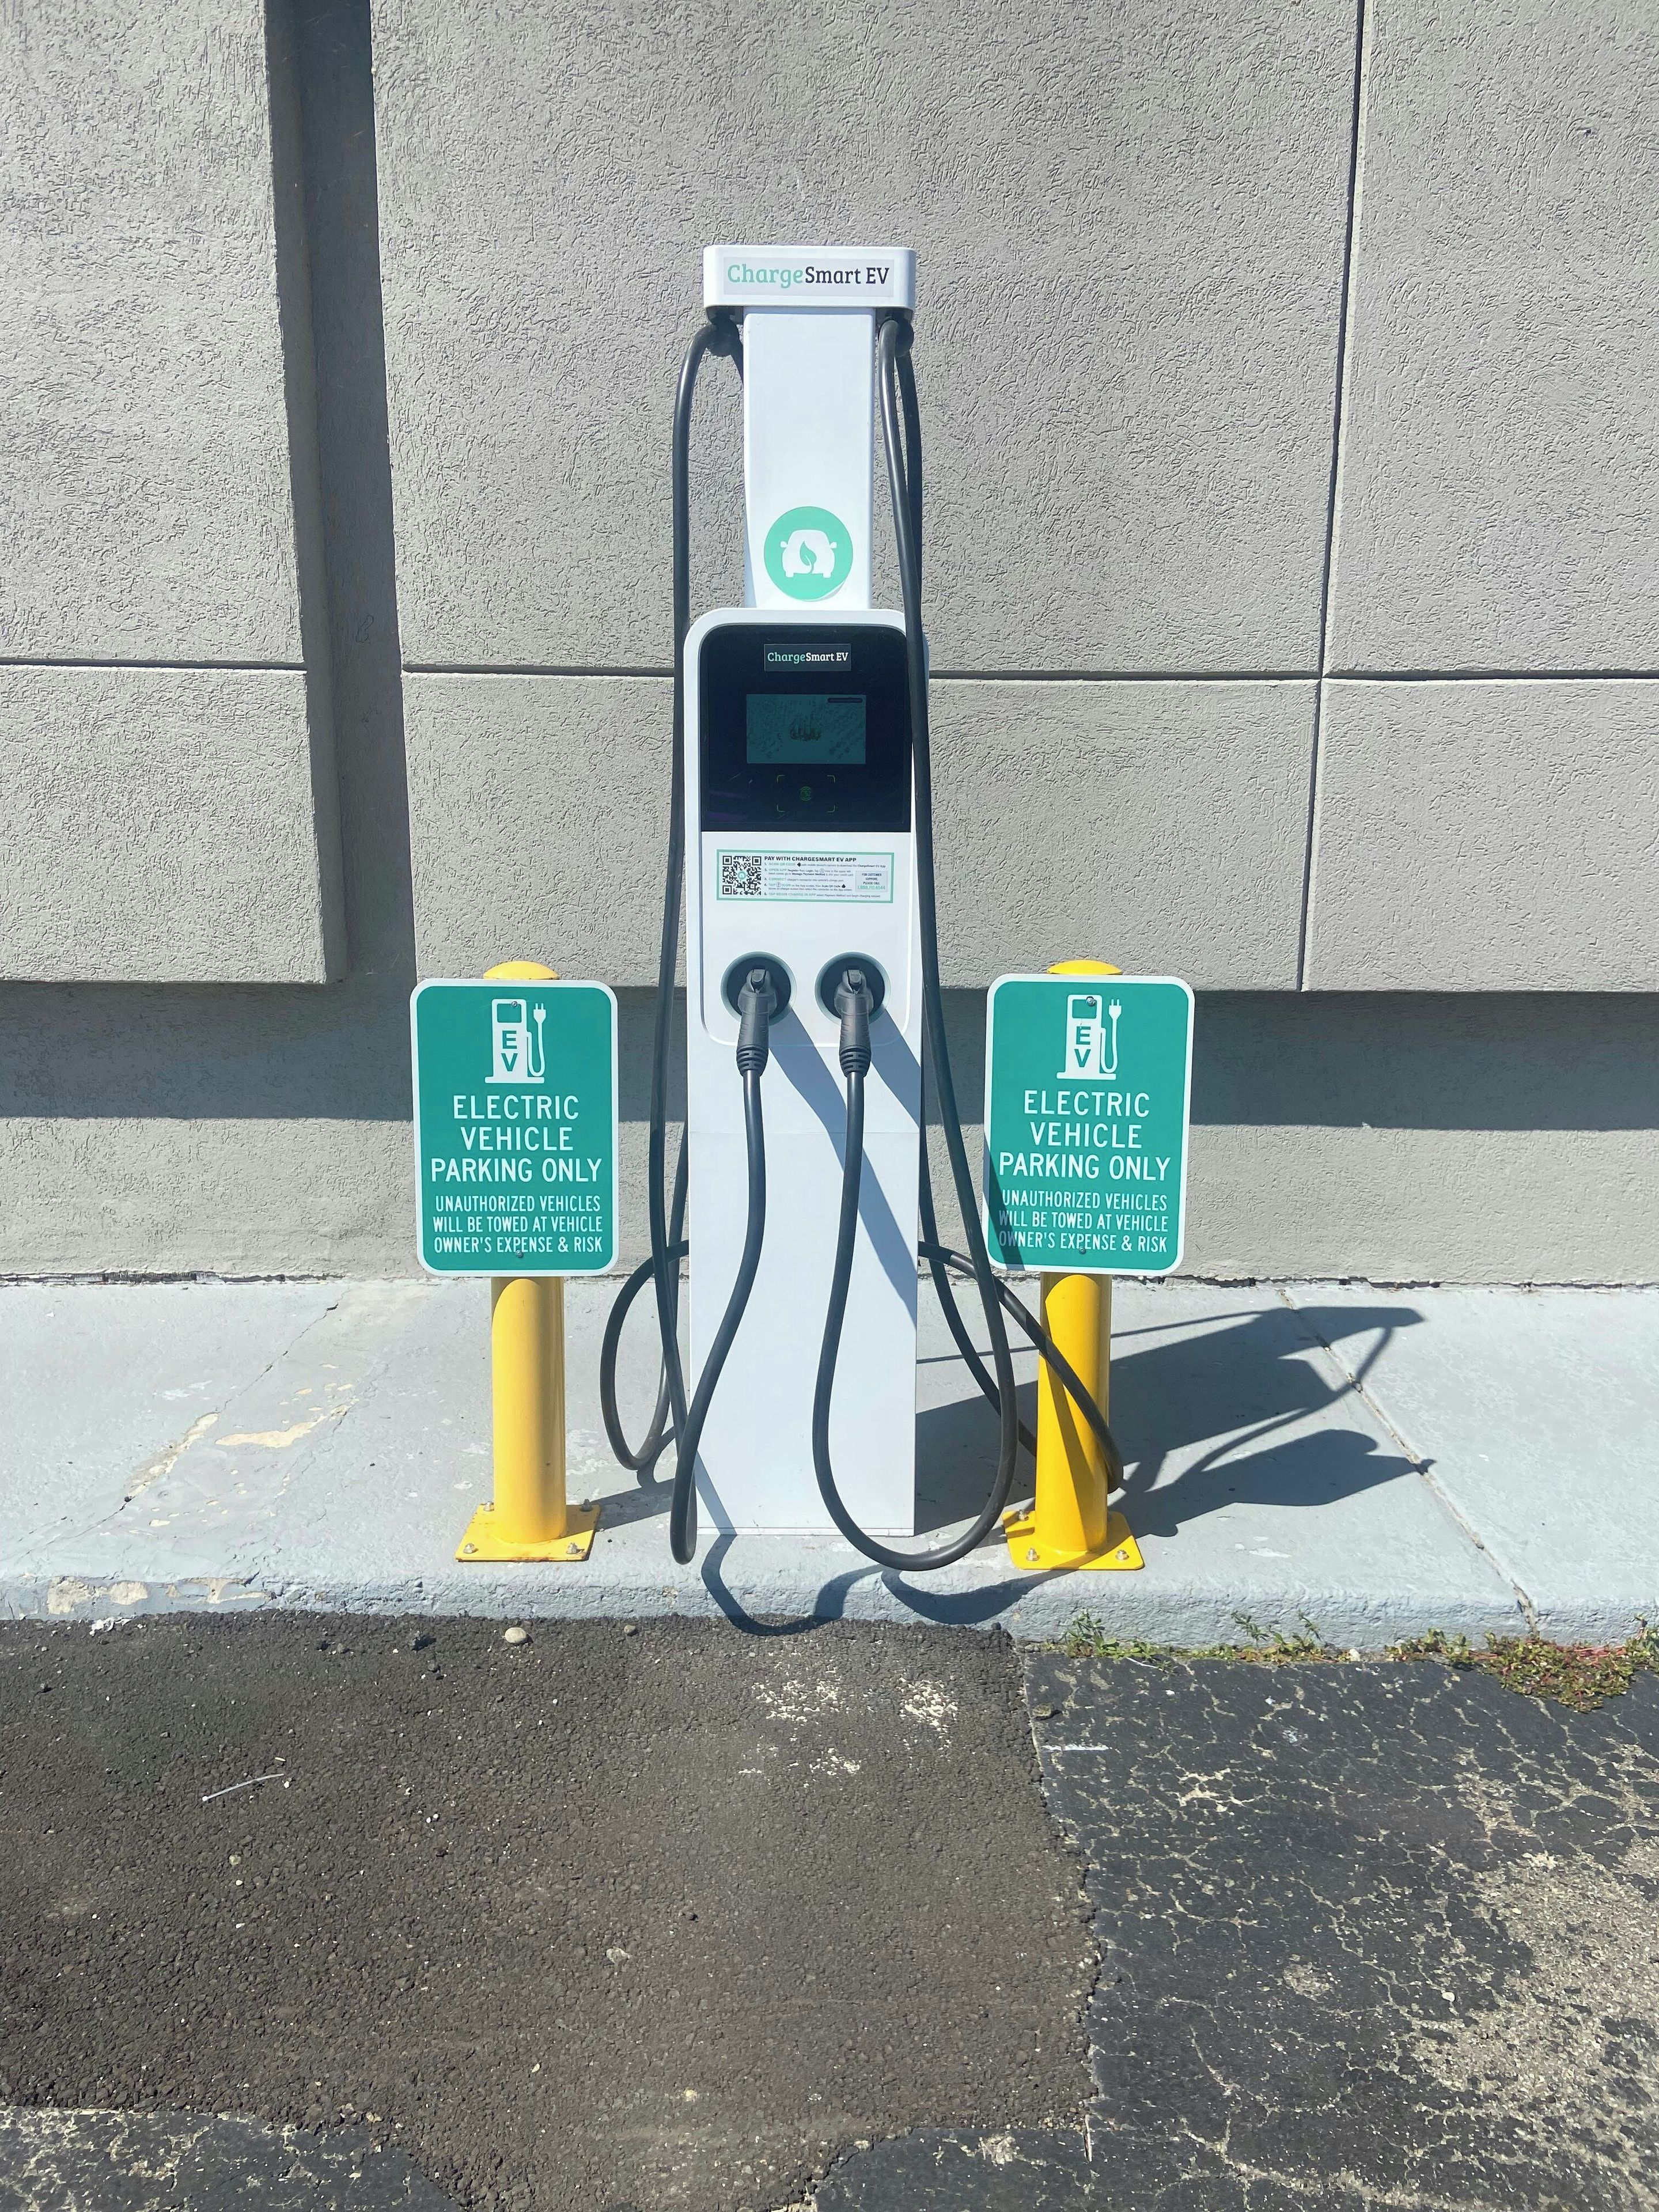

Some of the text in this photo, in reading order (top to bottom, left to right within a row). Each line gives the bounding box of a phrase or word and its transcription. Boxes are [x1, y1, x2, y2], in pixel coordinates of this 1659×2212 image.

[728, 263, 890, 289] ChargeSmart EV
[767, 652, 849, 664] ChargeSmart EV
[501, 1030, 518, 1072] EV
[1073, 1025, 1091, 1068] EV
[453, 1095, 579, 1120] ELECTRIC
[1024, 1090, 1150, 1118] ELECTRIC
[460, 1127, 573, 1151] VEHICLE
[1030, 1122, 1142, 1149] VEHICLE
[431, 1158, 602, 1182] PARKING ONLY
[999, 1152, 1171, 1181] PARKING ONLY
[435, 1195, 600, 1212] UNAUTHORIZED VEHICLES
[1002, 1189, 1167, 1211] UNAUTHORIZED VEHICLES
[433, 1216, 603, 1232] WILL BE TOWED AT VEHICLE
[998, 1210, 1168, 1232] WILL BE TOWED AT VEHICLE
[434, 1236, 603, 1253] OWNER'S EXPENSE & RISK
[998, 1230, 1167, 1252] OWNER'S EXPENSE & RISK
